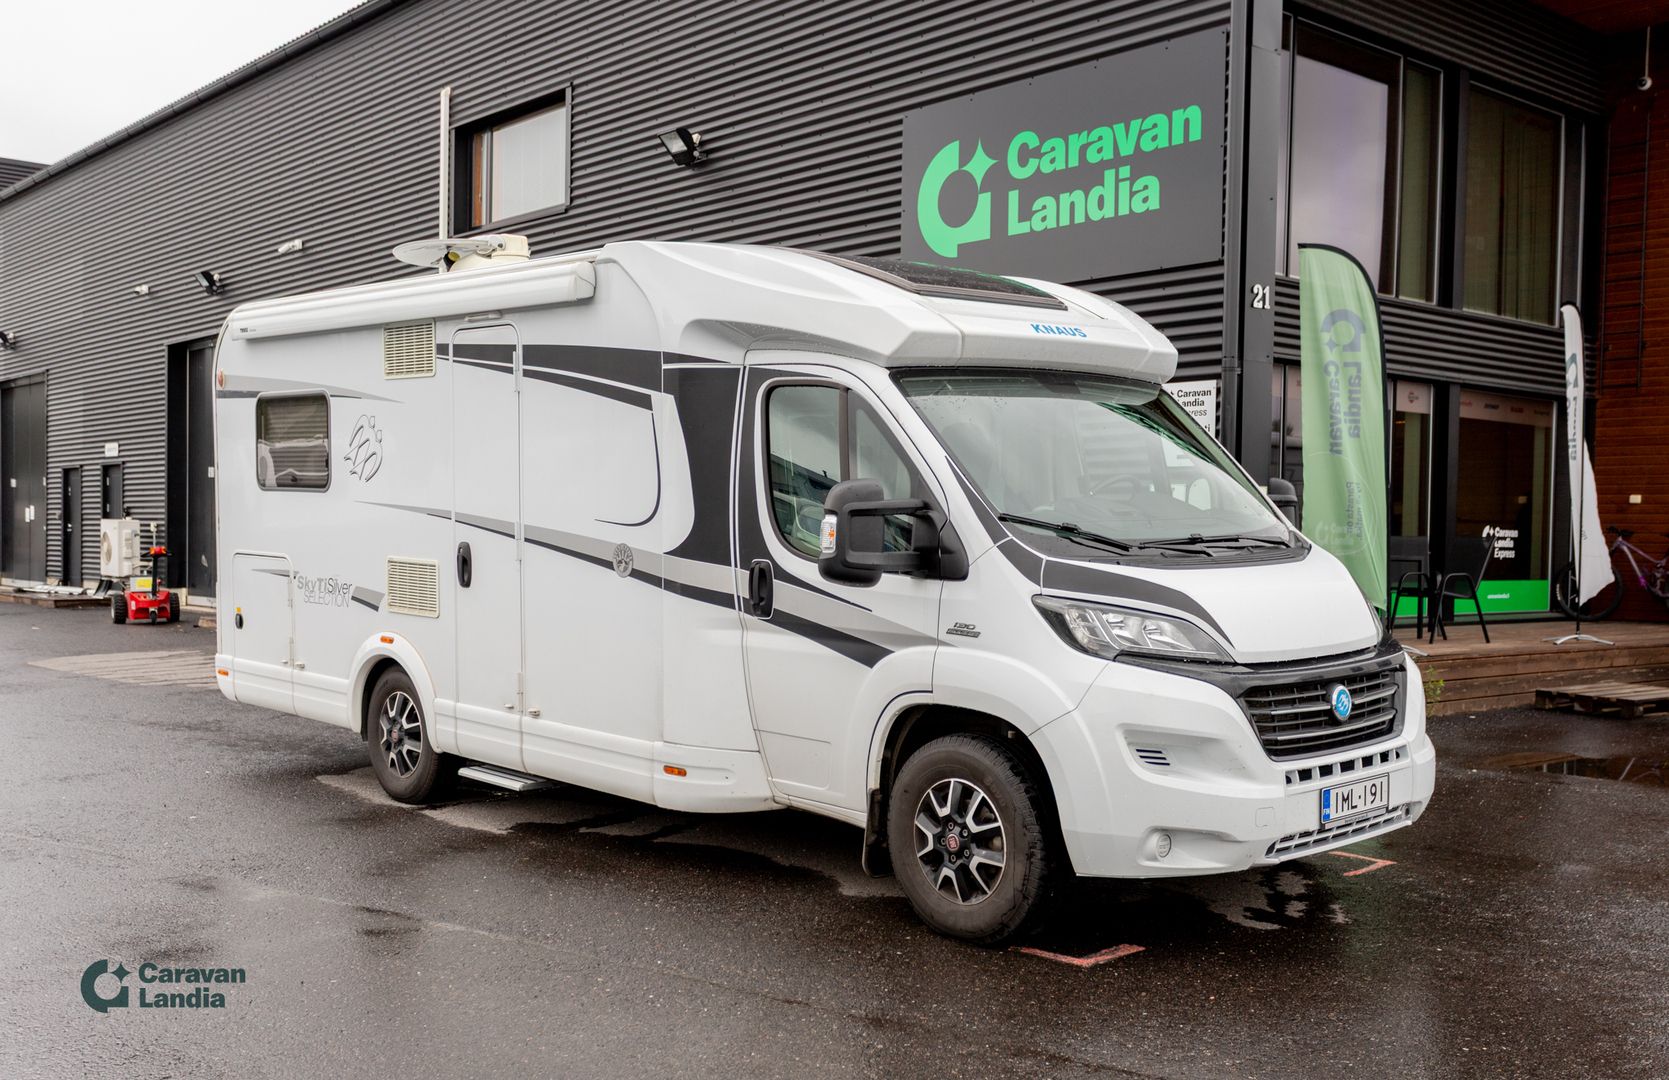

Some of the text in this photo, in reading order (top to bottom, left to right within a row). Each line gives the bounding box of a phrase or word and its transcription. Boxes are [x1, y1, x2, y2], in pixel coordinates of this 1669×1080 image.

[1006, 103, 1203, 180] Caravan
[1007, 164, 1161, 236] Landia
[1252, 283, 1272, 309] 21
[1030, 323, 1088, 338] KNAUS
[1177, 390, 1212, 398] Caravan
[1179, 398, 1205, 407] andia
[1494, 527, 1518, 538] Caravan
[1494, 548, 1515, 560] Express
